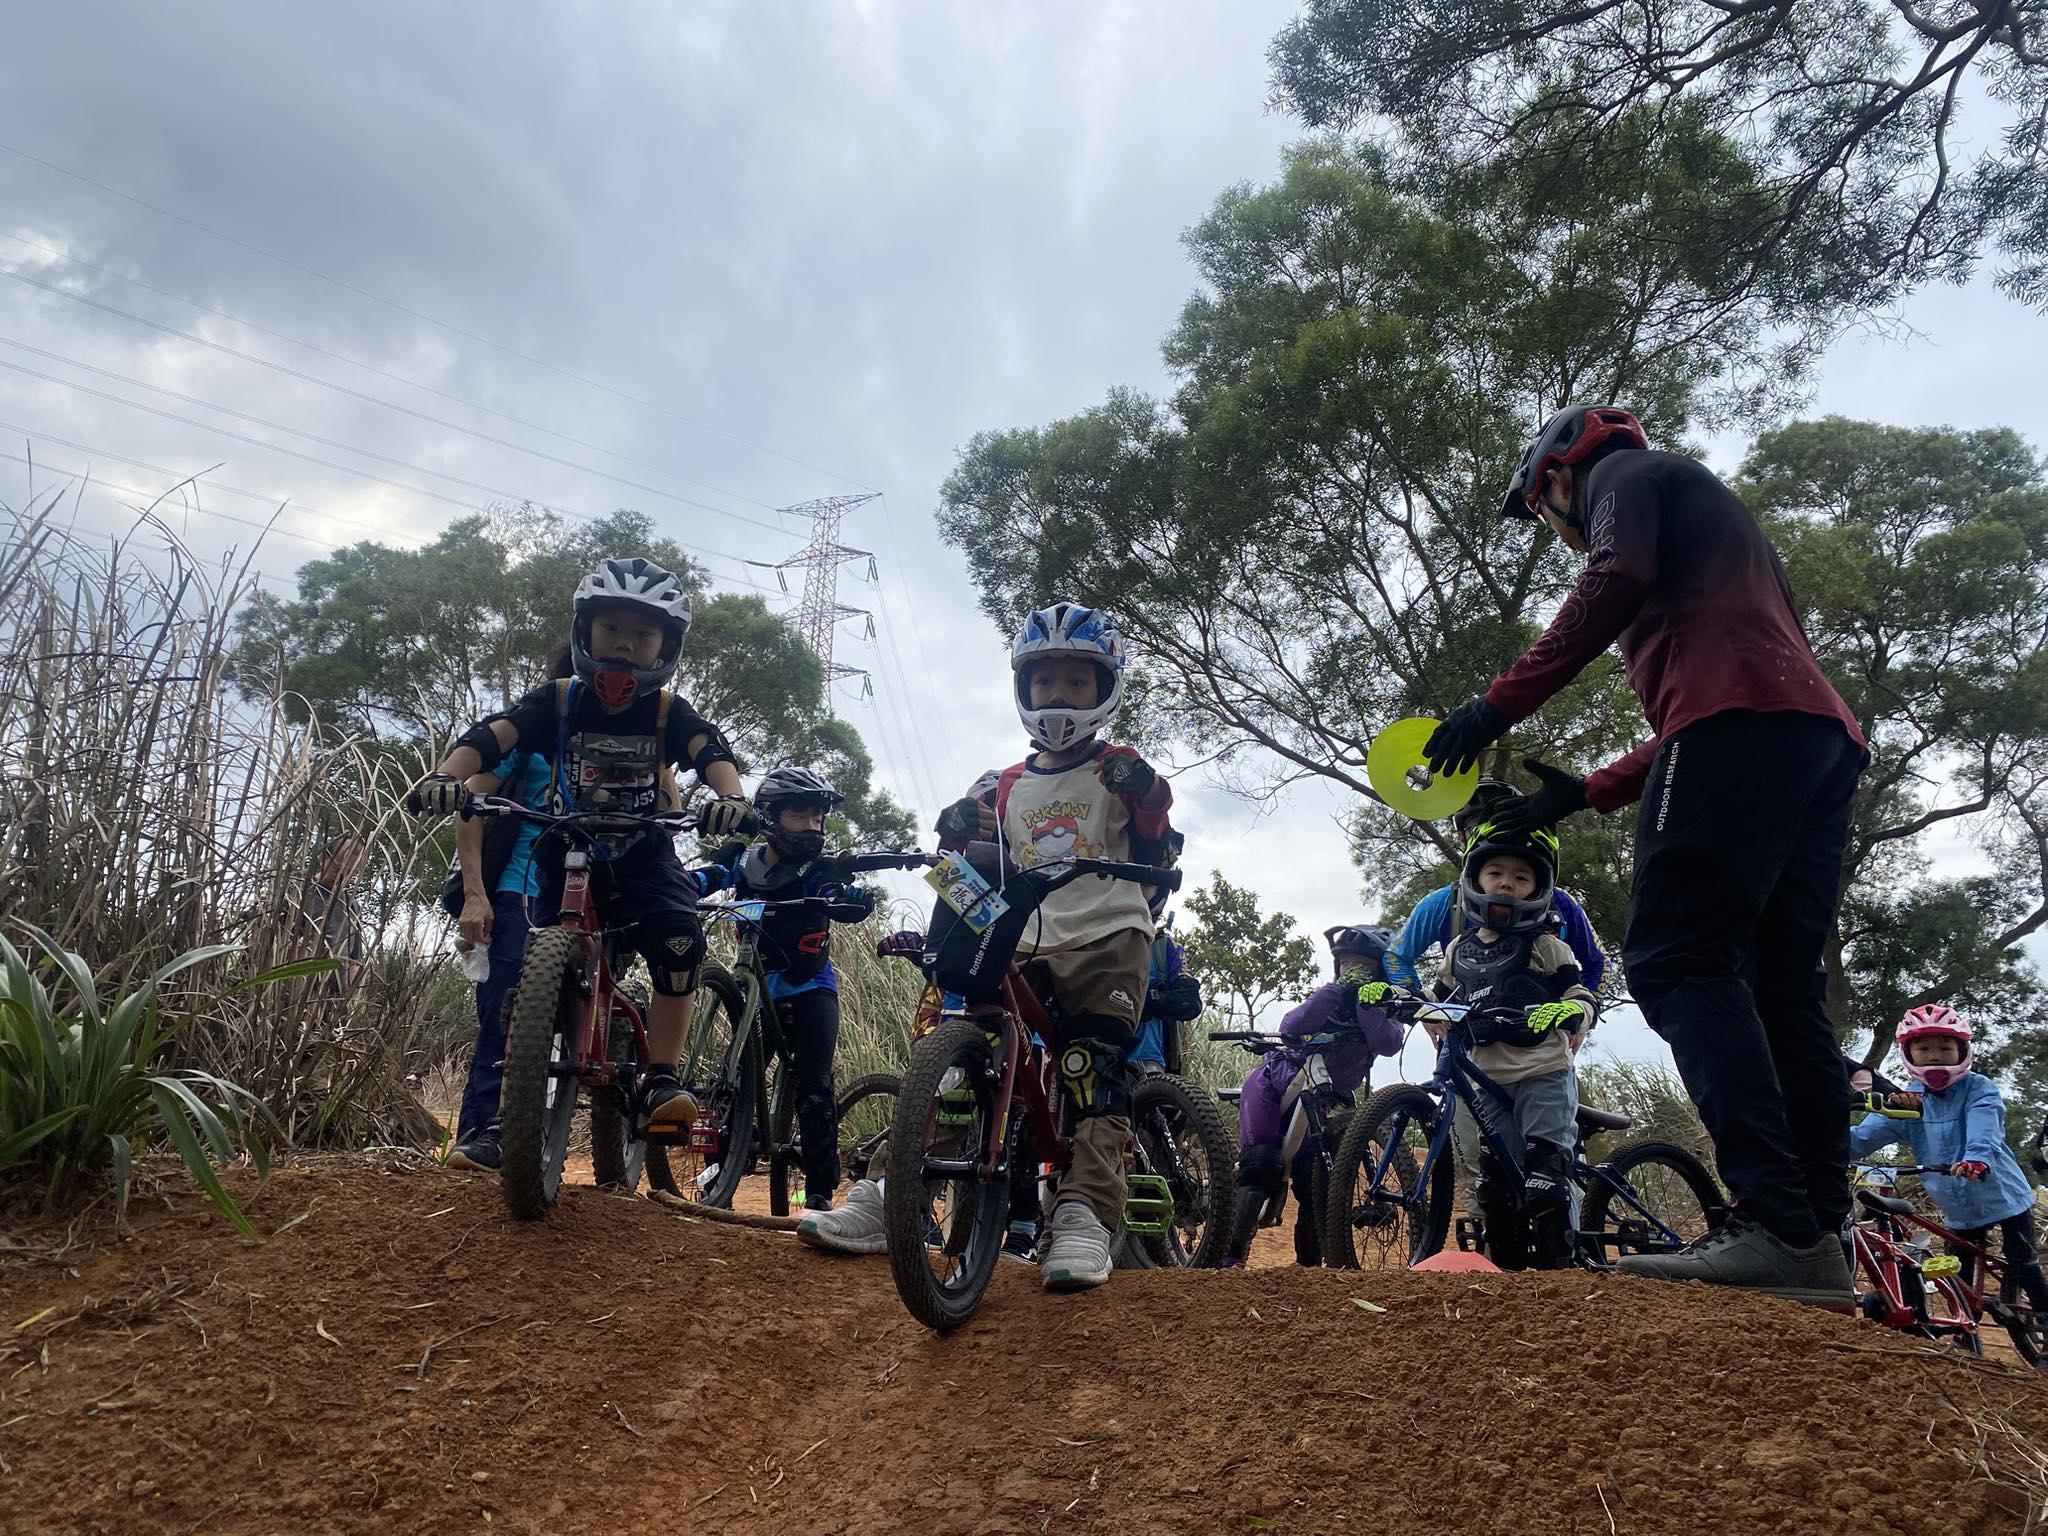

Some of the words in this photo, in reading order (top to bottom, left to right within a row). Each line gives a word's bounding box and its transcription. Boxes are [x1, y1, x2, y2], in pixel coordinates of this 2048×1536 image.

[1656, 787, 1671, 831] OUTDOOR
[1665, 742, 1680, 785] RESEARCH
[969, 950, 985, 976] Bottle
[1468, 985, 1494, 1002] LEATT
[1524, 1178, 1557, 1190] LEATT
